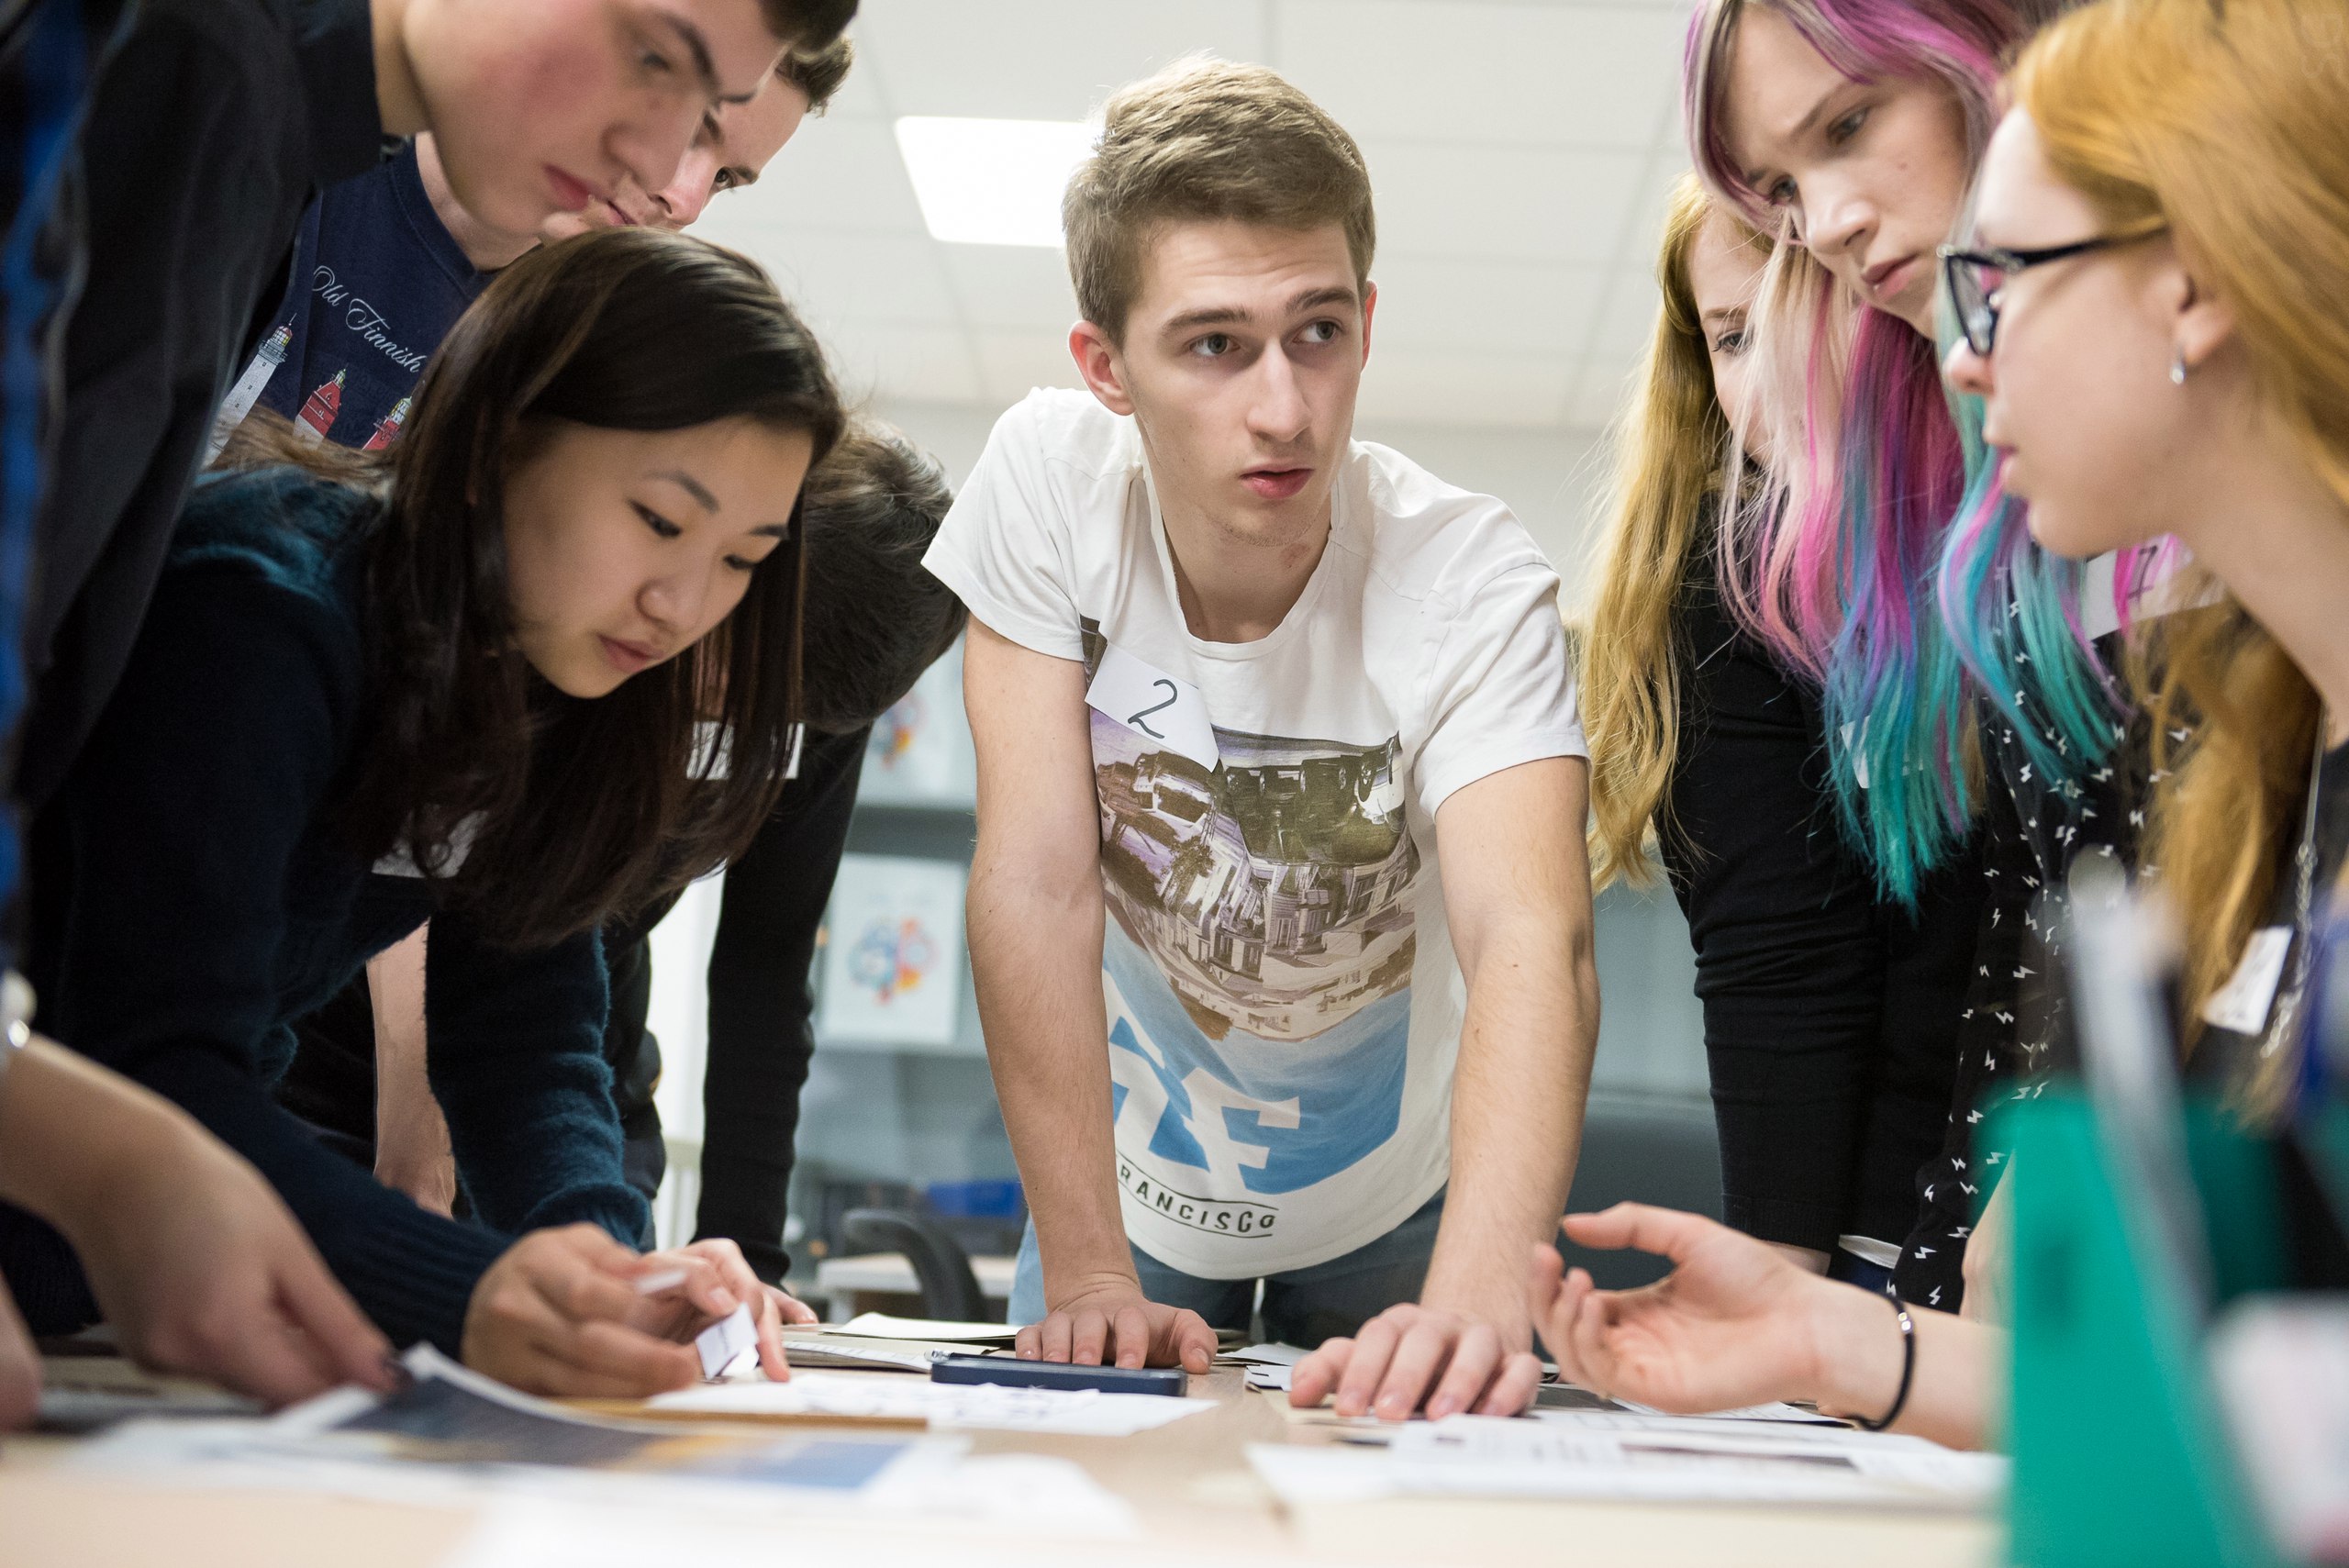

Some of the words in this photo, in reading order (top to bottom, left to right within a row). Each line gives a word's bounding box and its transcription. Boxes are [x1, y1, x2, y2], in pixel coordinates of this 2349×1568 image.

[311, 265, 349, 306] Old
[346, 298, 428, 373] Finnish
[1128, 679, 1177, 739] 2
[1119, 1163, 1276, 1234] RANCISCO
